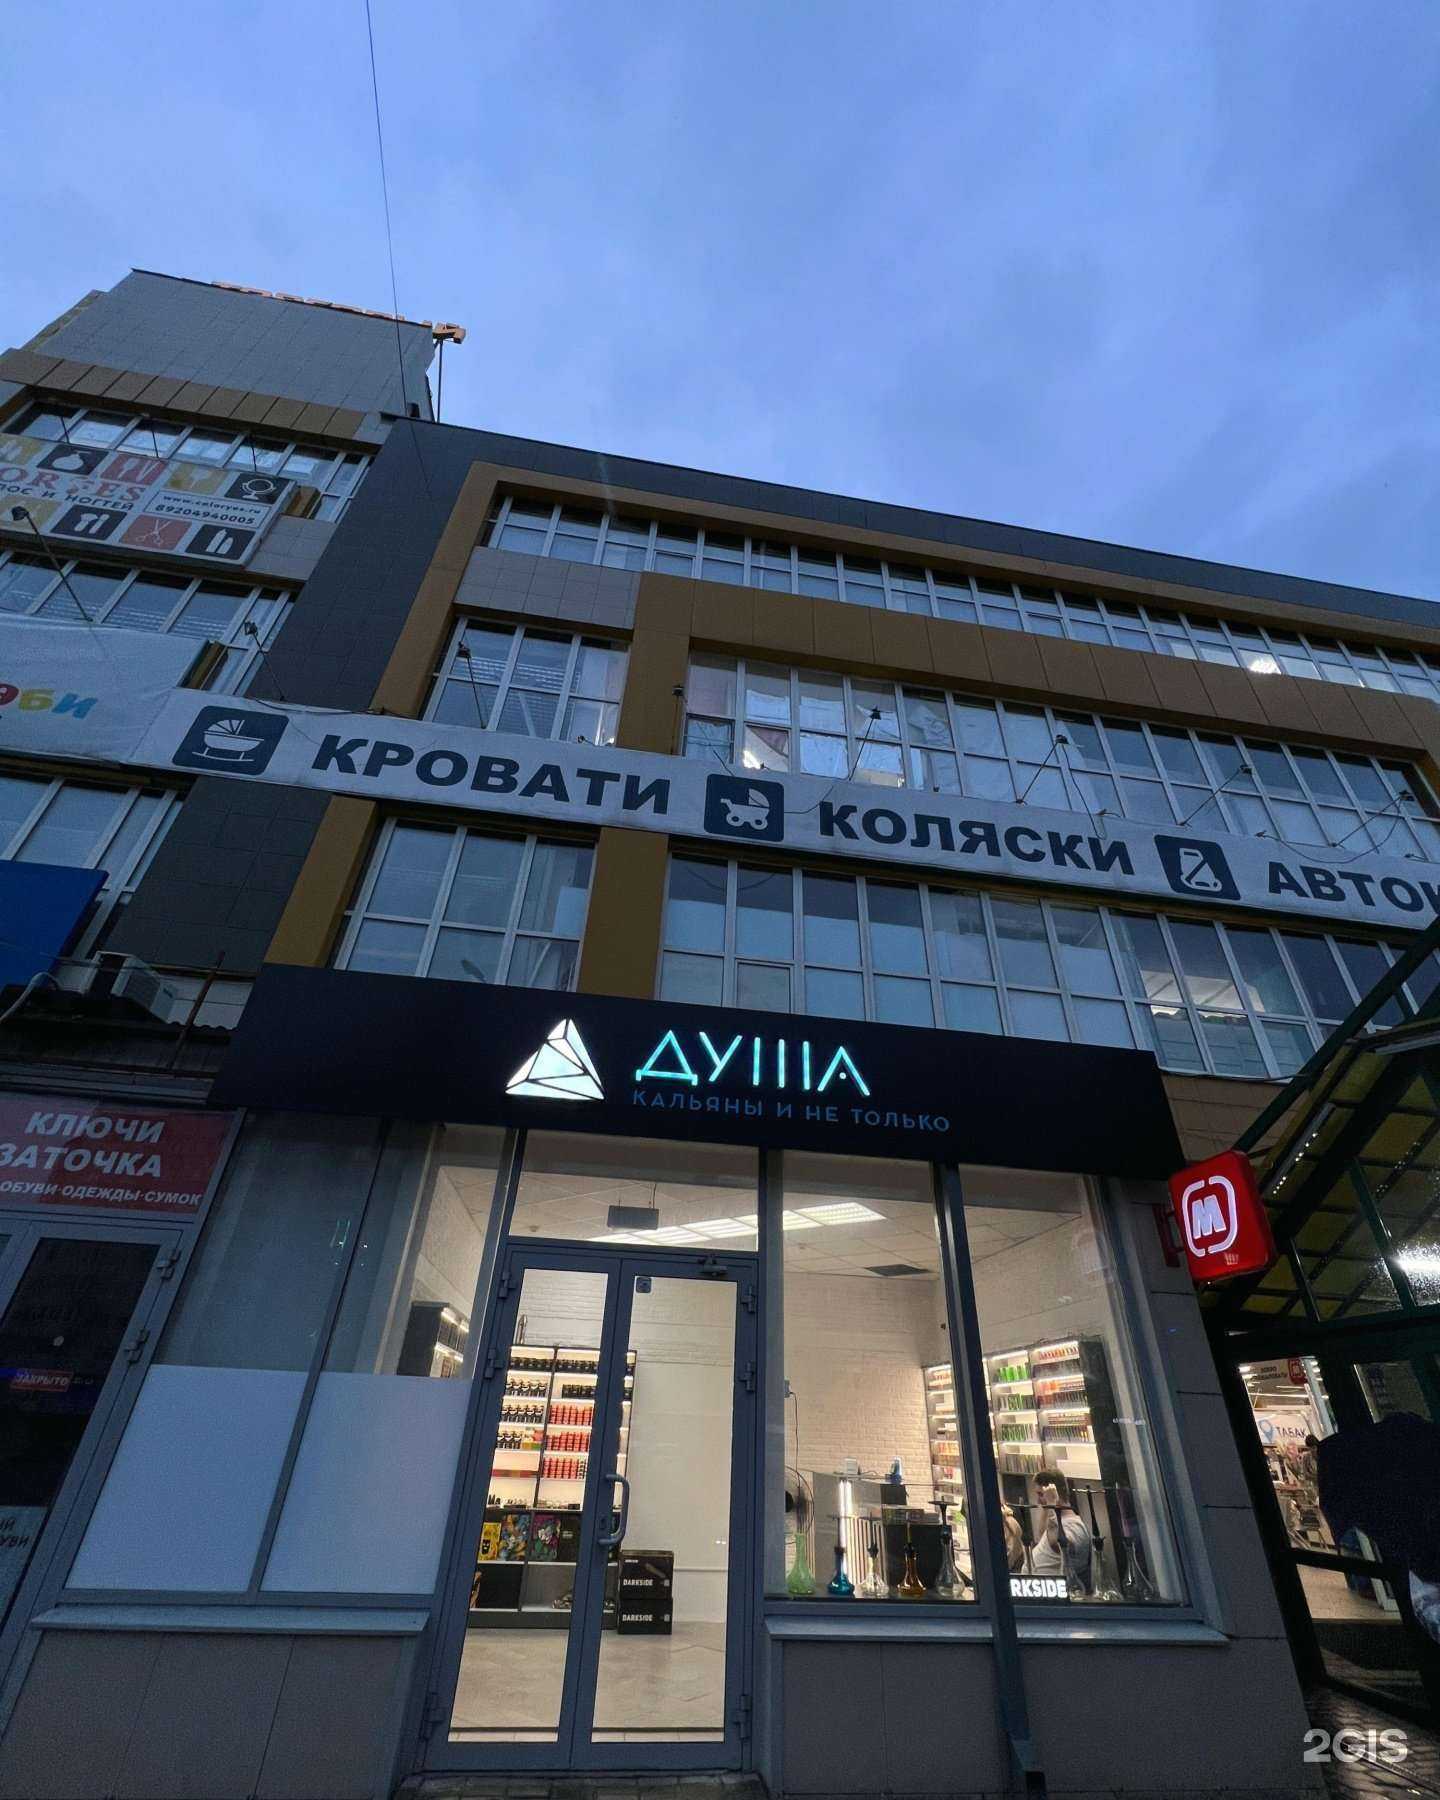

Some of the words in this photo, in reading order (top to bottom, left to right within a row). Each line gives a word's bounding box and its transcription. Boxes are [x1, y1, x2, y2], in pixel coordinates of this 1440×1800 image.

[311, 734, 671, 815] КРОВАТИ
[819, 800, 1135, 876] КОЛЯСКИ
[635, 1029, 871, 1096] ДУША
[24, 1111, 165, 1143] КЛЮЧИ
[632, 1089, 762, 1117] КАЛЬЯНЫ
[776, 1102, 792, 1119] И
[806, 1105, 839, 1123] НЕ
[850, 1108, 950, 1132] ТОЛЬКО
[0, 1142, 161, 1178] ЗАТОЧКА
[1276, 1426, 1306, 1439] ТАБАК
[622, 1578, 654, 1587] DARKSIDE
[621, 1613, 654, 1623] DARKSIDE
